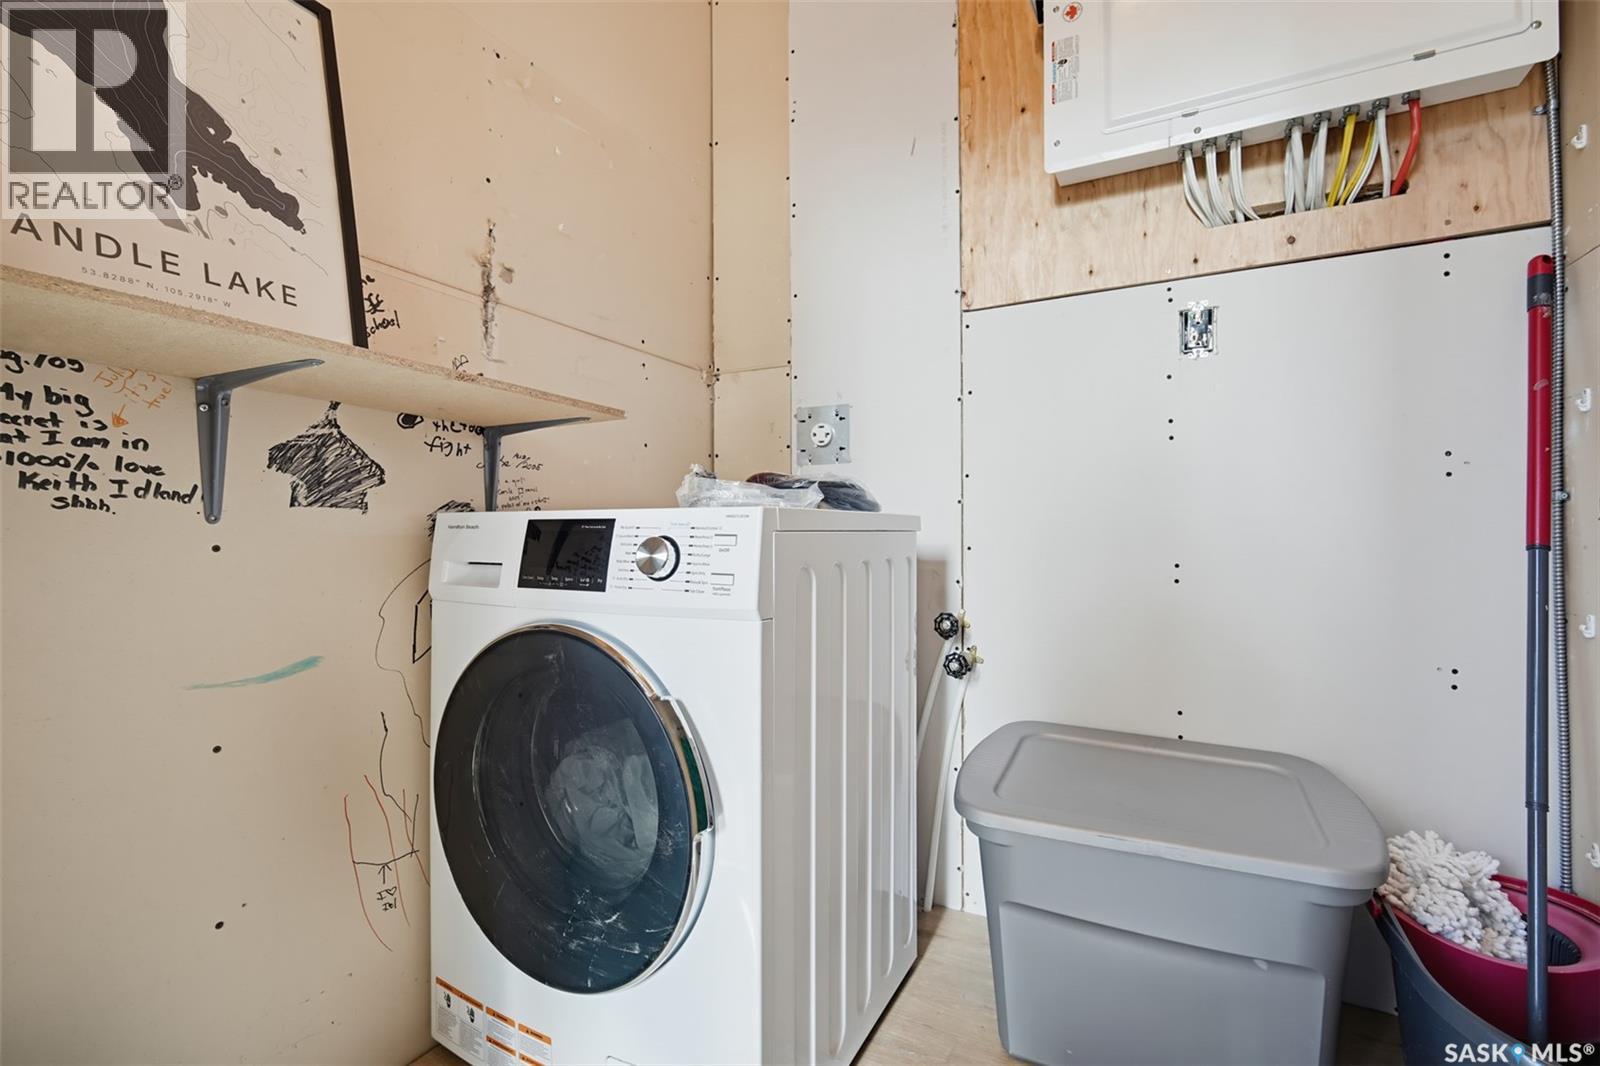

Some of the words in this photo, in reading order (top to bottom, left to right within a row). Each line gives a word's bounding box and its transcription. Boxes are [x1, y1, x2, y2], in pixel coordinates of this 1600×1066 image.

[10, 212, 181, 276] ANDLE
[203, 262, 298, 307] LAKE
[222, 300, 231, 308] W
[43, 385, 94, 417] big
[0, 412, 64, 429] ecret
[40, 430, 64, 446] I
[71, 436, 110, 449] am
[122, 431, 149, 452] in
[424, 436, 471, 457] fight
[115, 455, 166, 477] love
[18, 470, 98, 492] Keith
